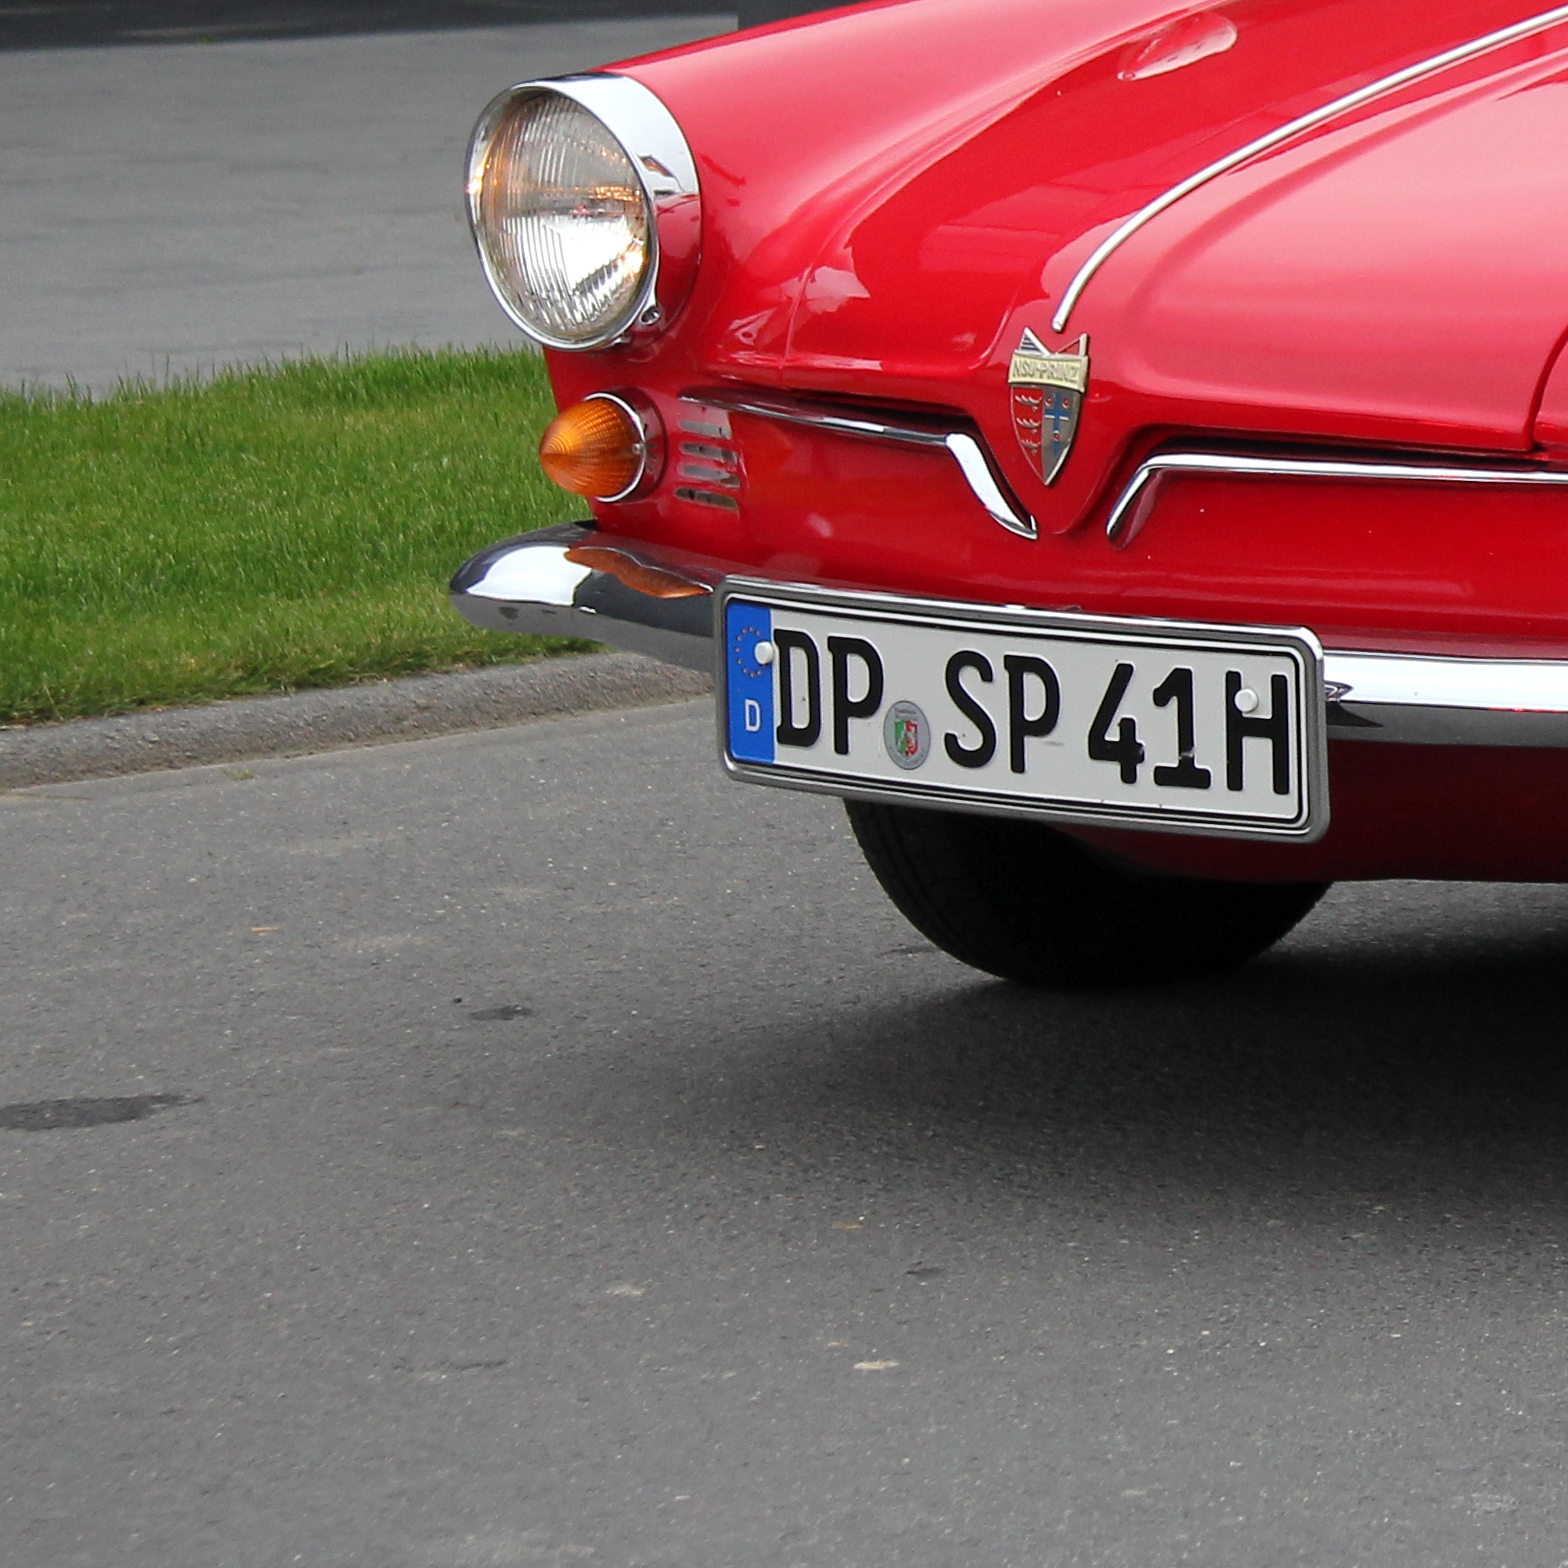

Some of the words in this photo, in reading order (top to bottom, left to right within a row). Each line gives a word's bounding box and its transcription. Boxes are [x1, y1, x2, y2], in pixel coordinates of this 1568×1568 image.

[1012, 358, 1035, 378] NSU
[1037, 361, 1079, 383] PRINZ
[744, 698, 761, 732] D
[773, 628, 884, 755] DP
[943, 649, 1060, 773] SP
[1088, 662, 1290, 795] 41H
